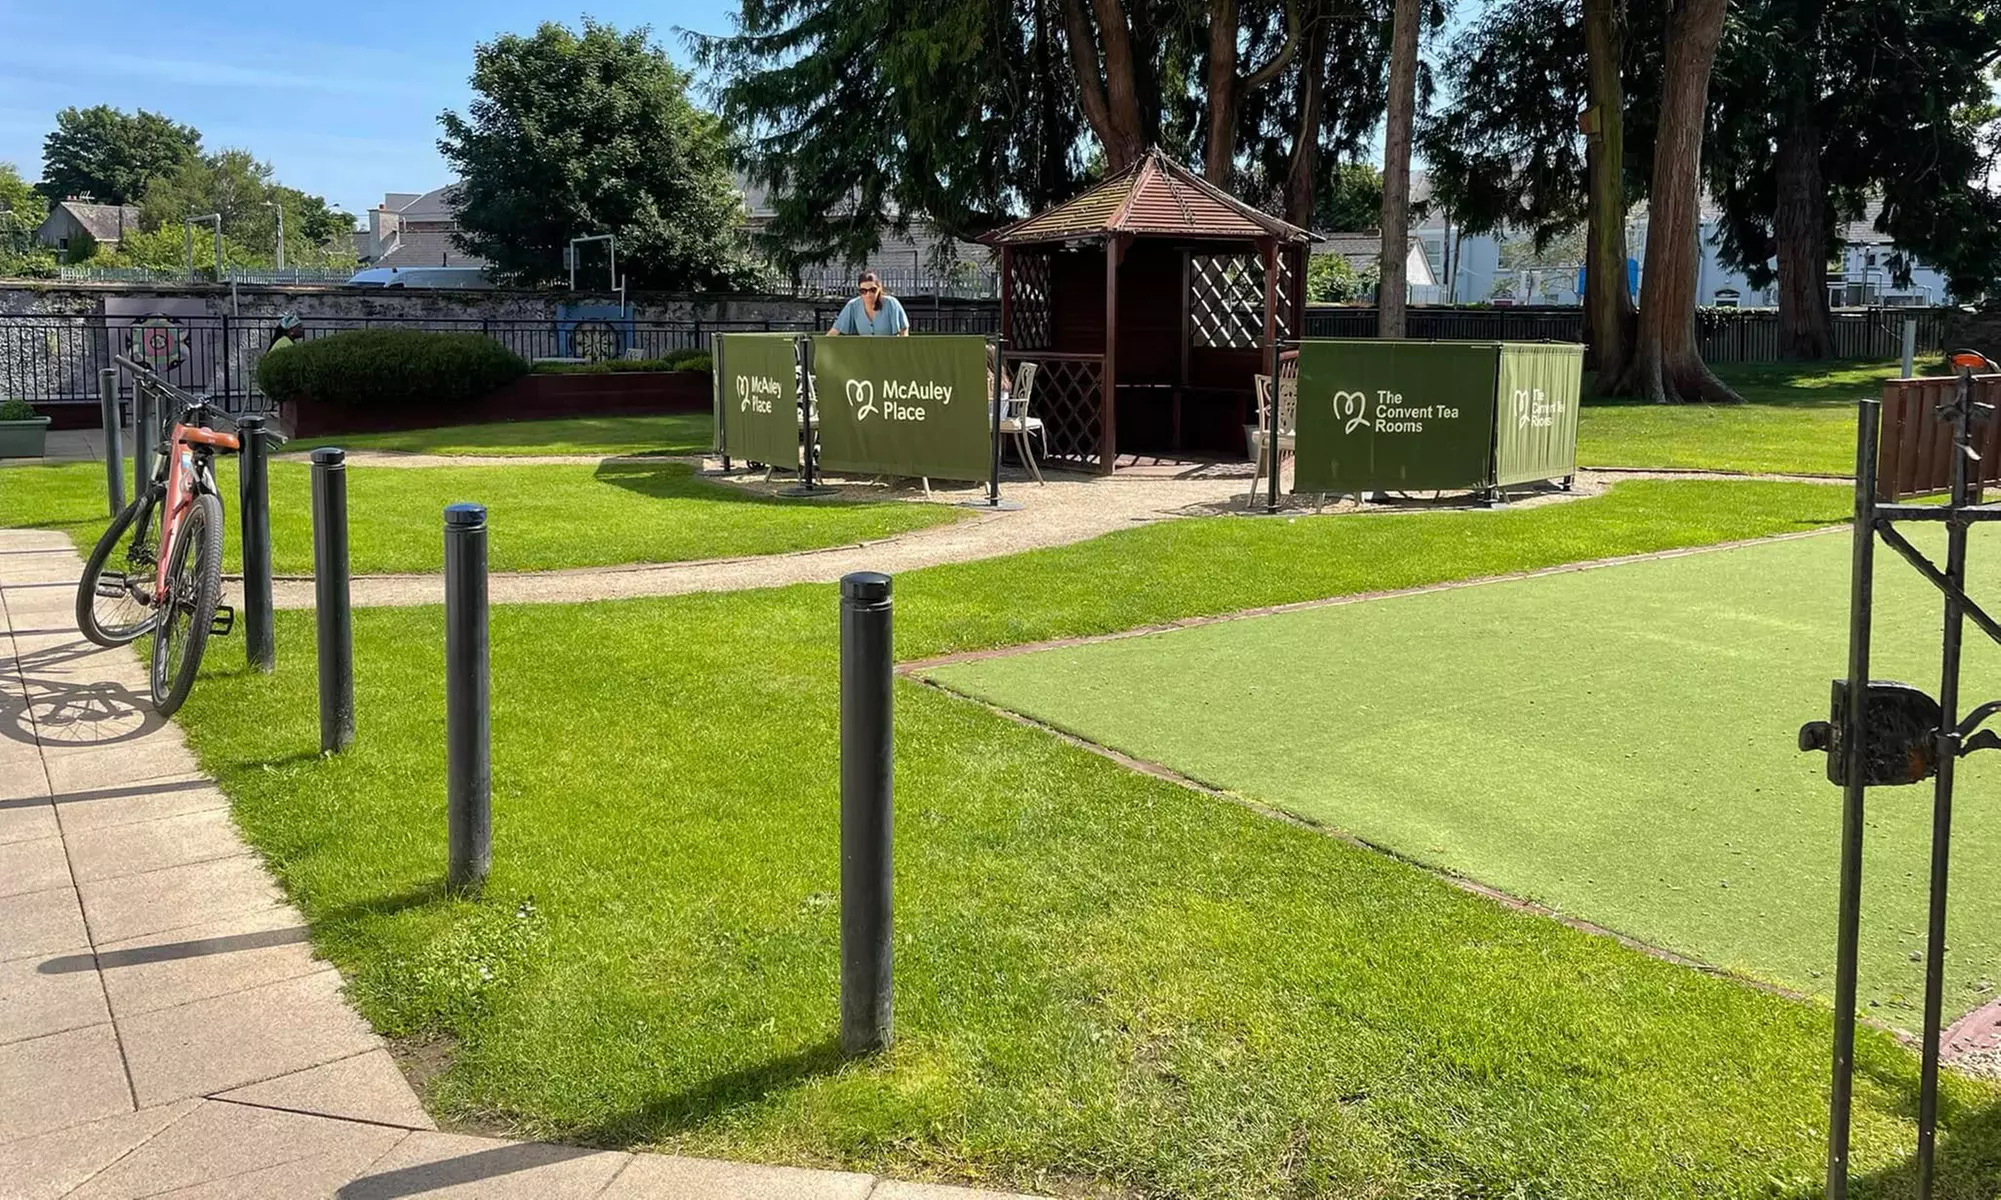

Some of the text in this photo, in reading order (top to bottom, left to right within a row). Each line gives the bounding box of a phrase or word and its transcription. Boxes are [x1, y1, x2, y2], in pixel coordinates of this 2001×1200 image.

[882, 379, 953, 405] McAuley
[1377, 390, 1403, 404] The
[883, 401, 926, 420] Place
[1375, 404, 1459, 419] Convent Tea
[1375, 418, 1423, 433] Rooms
